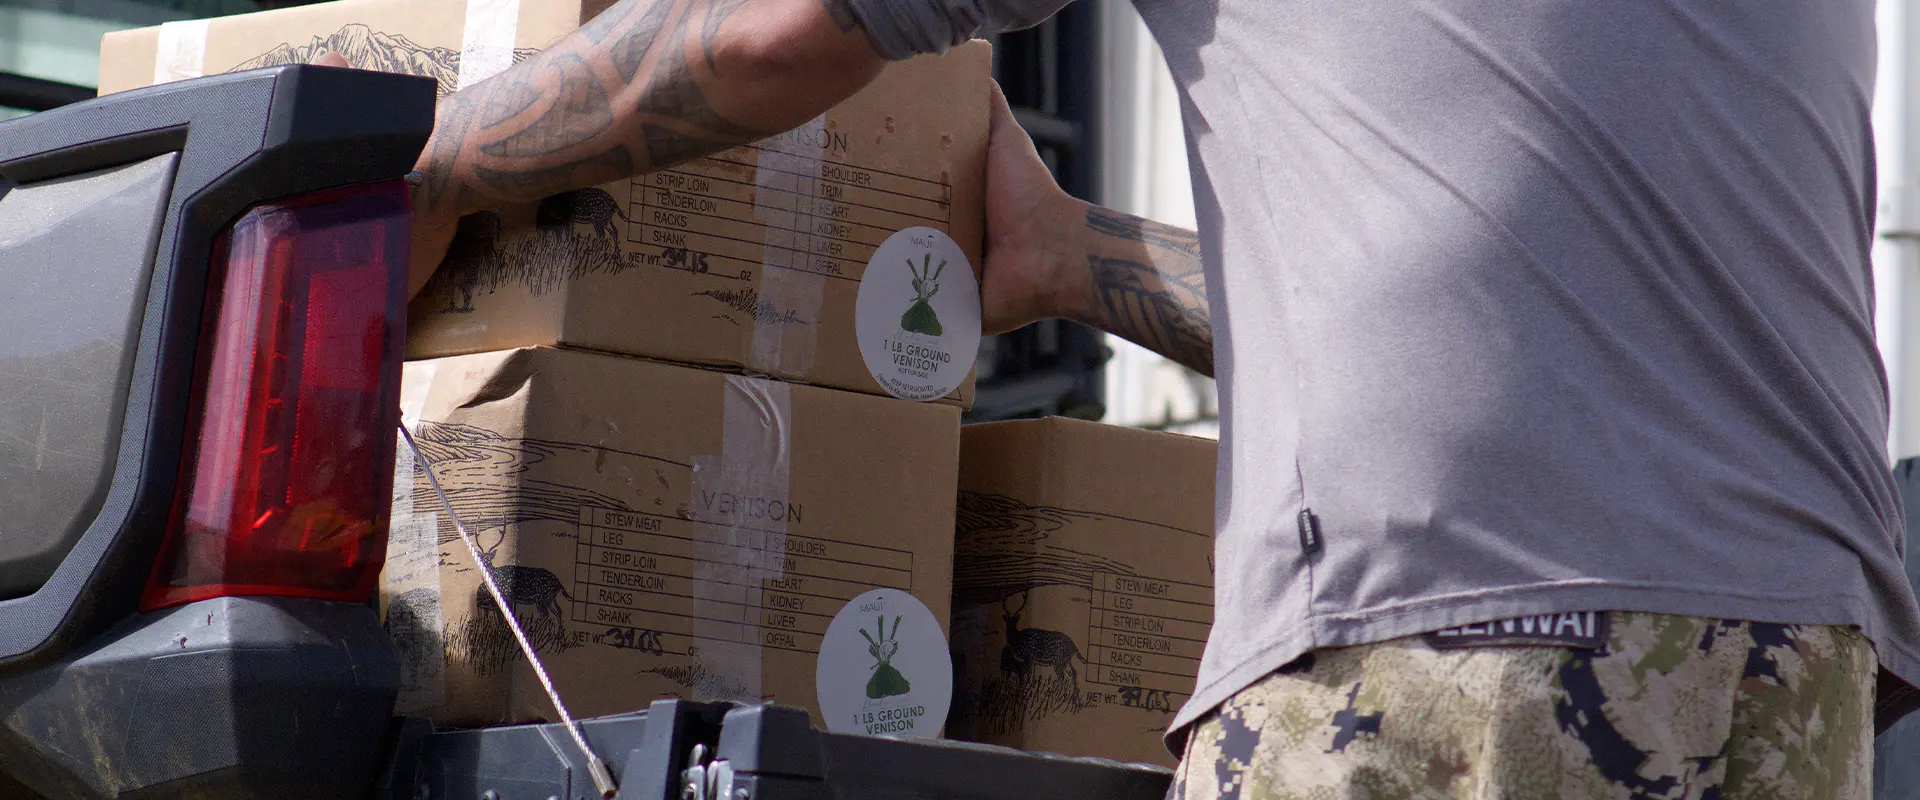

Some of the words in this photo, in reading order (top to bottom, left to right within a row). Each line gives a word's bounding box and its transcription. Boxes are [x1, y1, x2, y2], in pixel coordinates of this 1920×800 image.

[656, 174, 685, 188] STRIP
[687, 179, 709, 192] LOIN
[821, 166, 871, 185] SHOULDER
[821, 184, 843, 197] TRIM
[656, 192, 717, 212] TENDERLOIN
[654, 211, 687, 227] RACKS
[819, 203, 850, 219] HEART
[818, 222, 851, 238] KIDNEY
[653, 231, 686, 247] SHANK
[911, 236, 933, 249] MAUI
[816, 240, 843, 255] LIVER
[628, 252, 646, 263] NET
[815, 260, 843, 275] OFFAL
[740, 271, 752, 281] OZ
[892, 341, 902, 353] LB
[906, 345, 950, 364] GROUND
[892, 352, 939, 373] VENISON
[702, 489, 802, 524] VENISON
[605, 513, 634, 528] STEW
[636, 518, 662, 532] MEAT
[603, 532, 623, 545] LEG
[602, 551, 632, 565] STRIP
[634, 555, 657, 570] LOIN
[601, 570, 664, 591] TENDERLOIN
[771, 578, 803, 590] HEART
[1115, 577, 1142, 592] STEW
[1144, 583, 1170, 597] MEAT
[600, 589, 633, 605] RACKS
[770, 595, 805, 610] KIDNEY
[1113, 596, 1133, 610] LEG
[860, 602, 883, 613] MAUI
[597, 608, 632, 625] SHANK
[768, 614, 796, 628] LIVER
[1113, 615, 1140, 630] STRIP
[1142, 619, 1164, 633] LOIN
[573, 631, 589, 643] NET
[766, 633, 796, 647] OFFAL
[1112, 633, 1171, 652] TENDERLOIN
[1111, 651, 1142, 666] RACKS
[1109, 670, 1141, 685] SHANK
[1086, 691, 1103, 702] NET
[863, 713, 874, 724] LB
[878, 705, 925, 722] GROUND
[866, 719, 914, 735] VENISON
